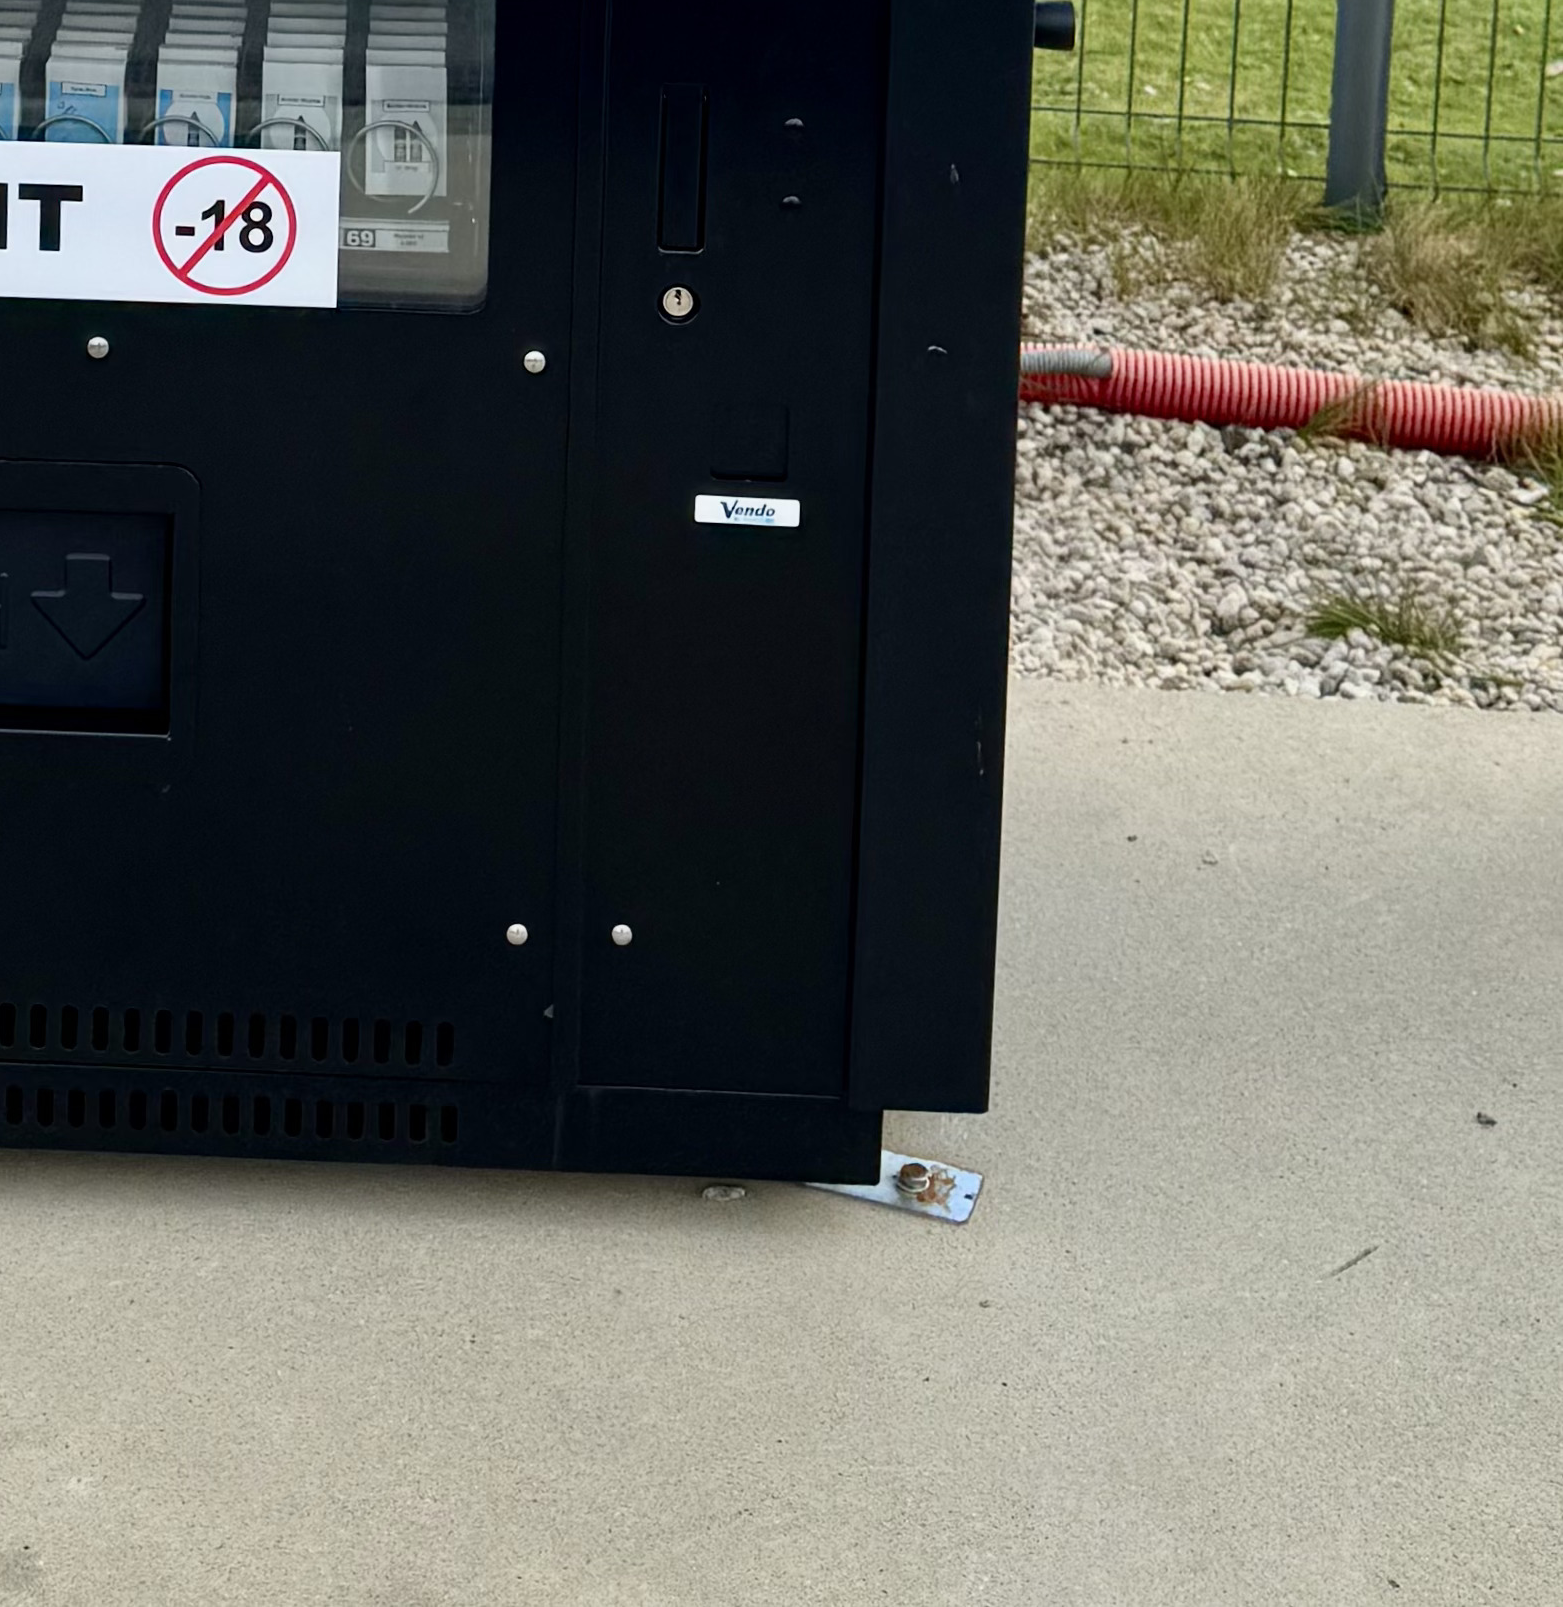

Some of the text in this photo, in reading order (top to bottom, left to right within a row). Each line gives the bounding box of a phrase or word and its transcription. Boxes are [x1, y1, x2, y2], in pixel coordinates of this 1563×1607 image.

[174, 198, 275, 255] -18
[346, 230, 374, 247] 69
[719, 499, 776, 519] Vendo
